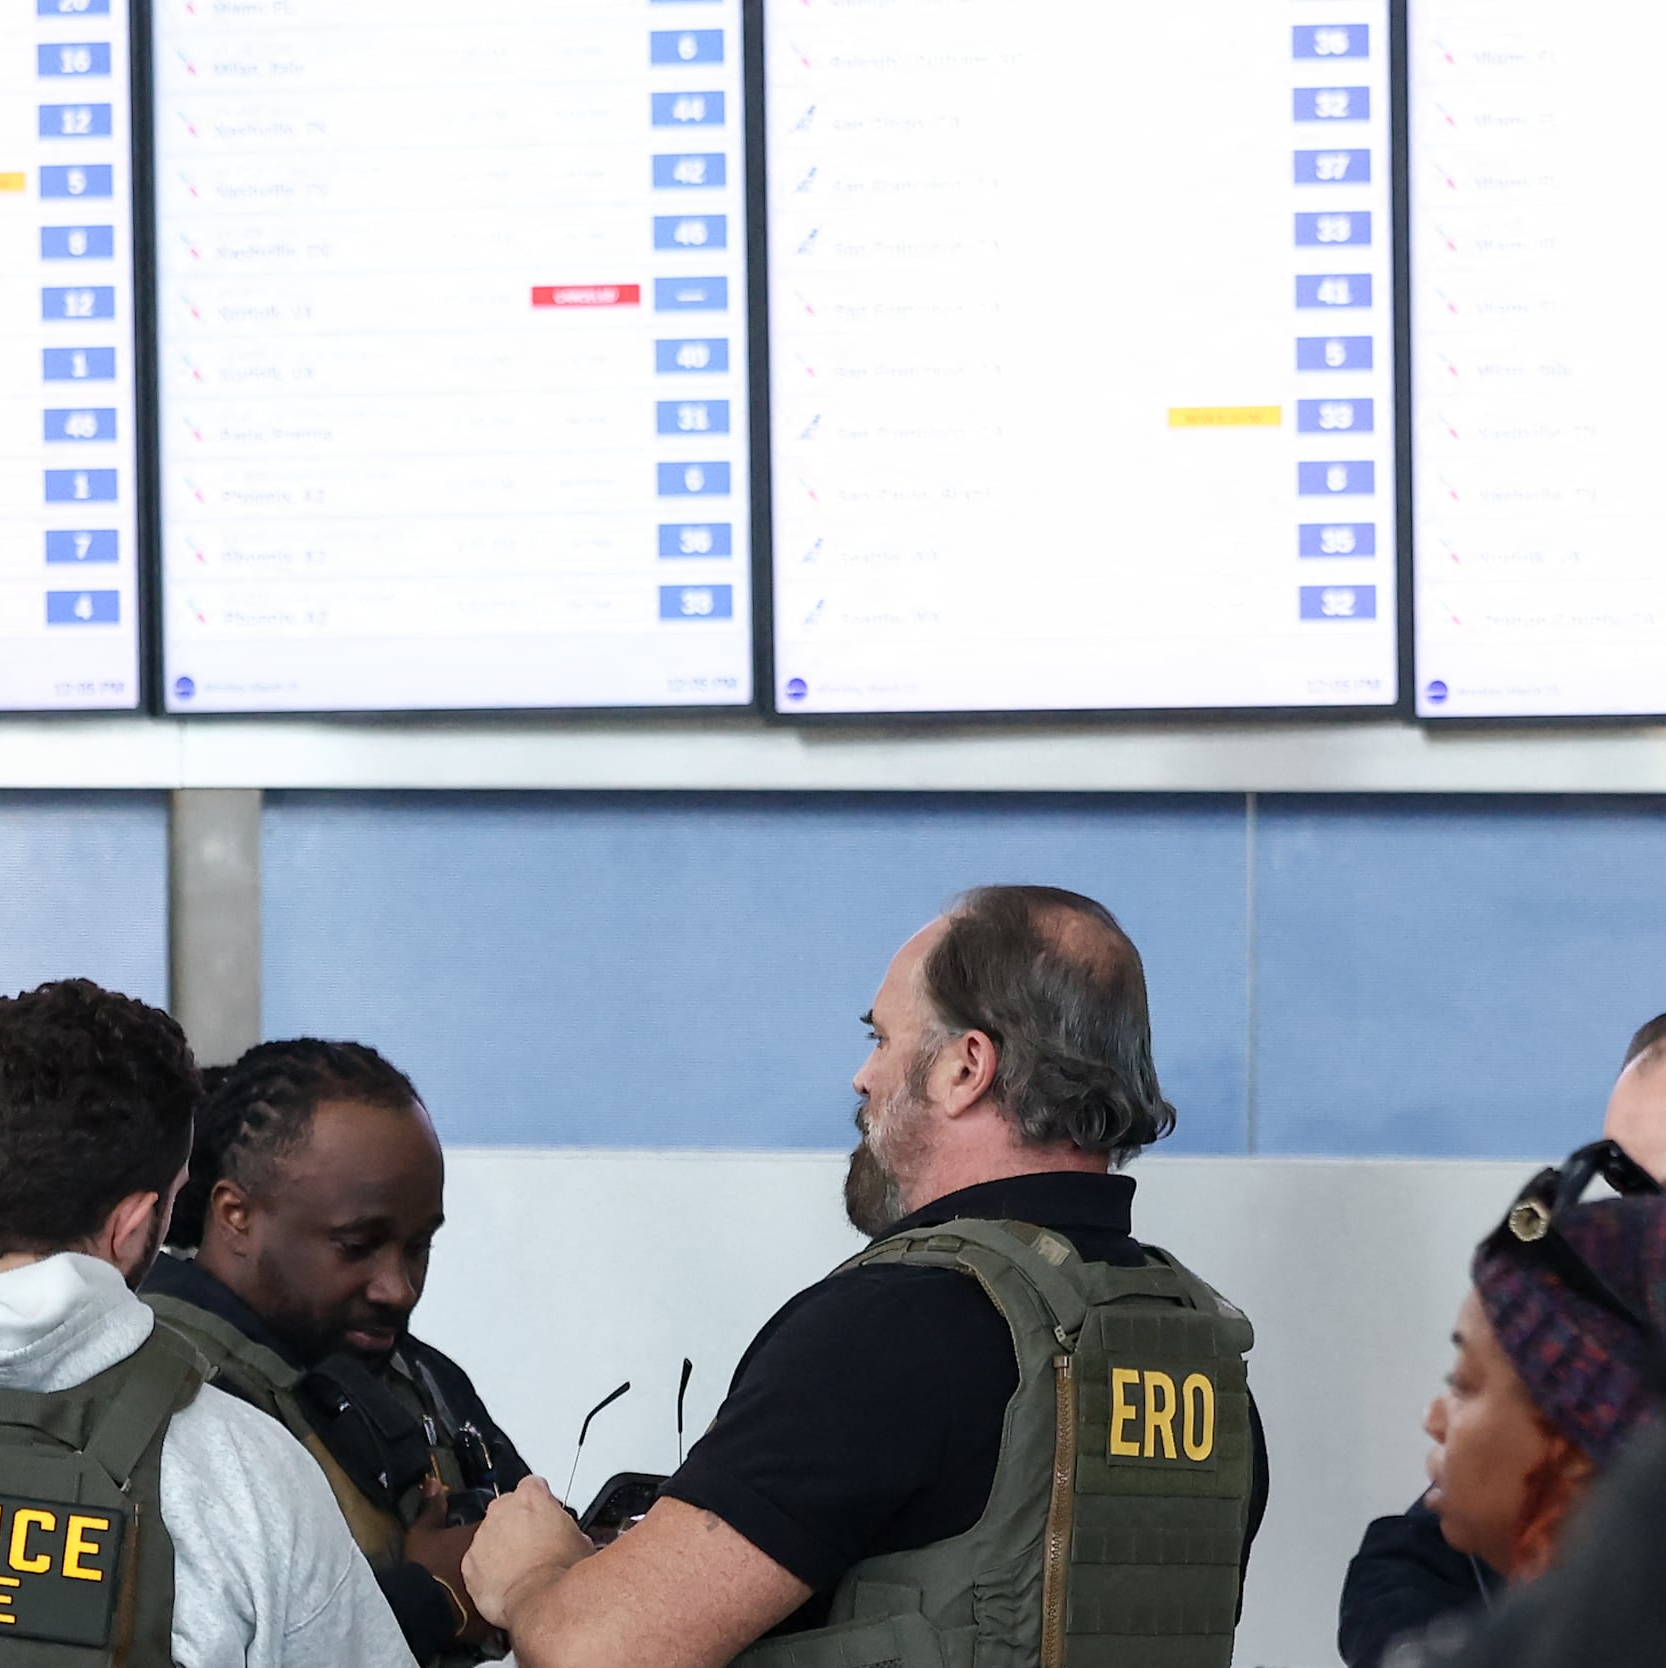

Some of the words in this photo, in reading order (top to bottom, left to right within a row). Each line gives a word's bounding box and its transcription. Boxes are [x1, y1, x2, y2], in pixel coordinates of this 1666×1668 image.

[62, 107, 92, 134] 12
[1316, 151, 1350, 180] 37
[67, 167, 87, 195] 5
[65, 289, 95, 316] 12
[72, 351, 88, 377] 1
[74, 472, 89, 499] 1
[74, 531, 92, 560] 7
[74, 594, 93, 620] 4
[1321, 588, 1356, 616] 32
[1109, 1367, 1214, 1461] ERO
